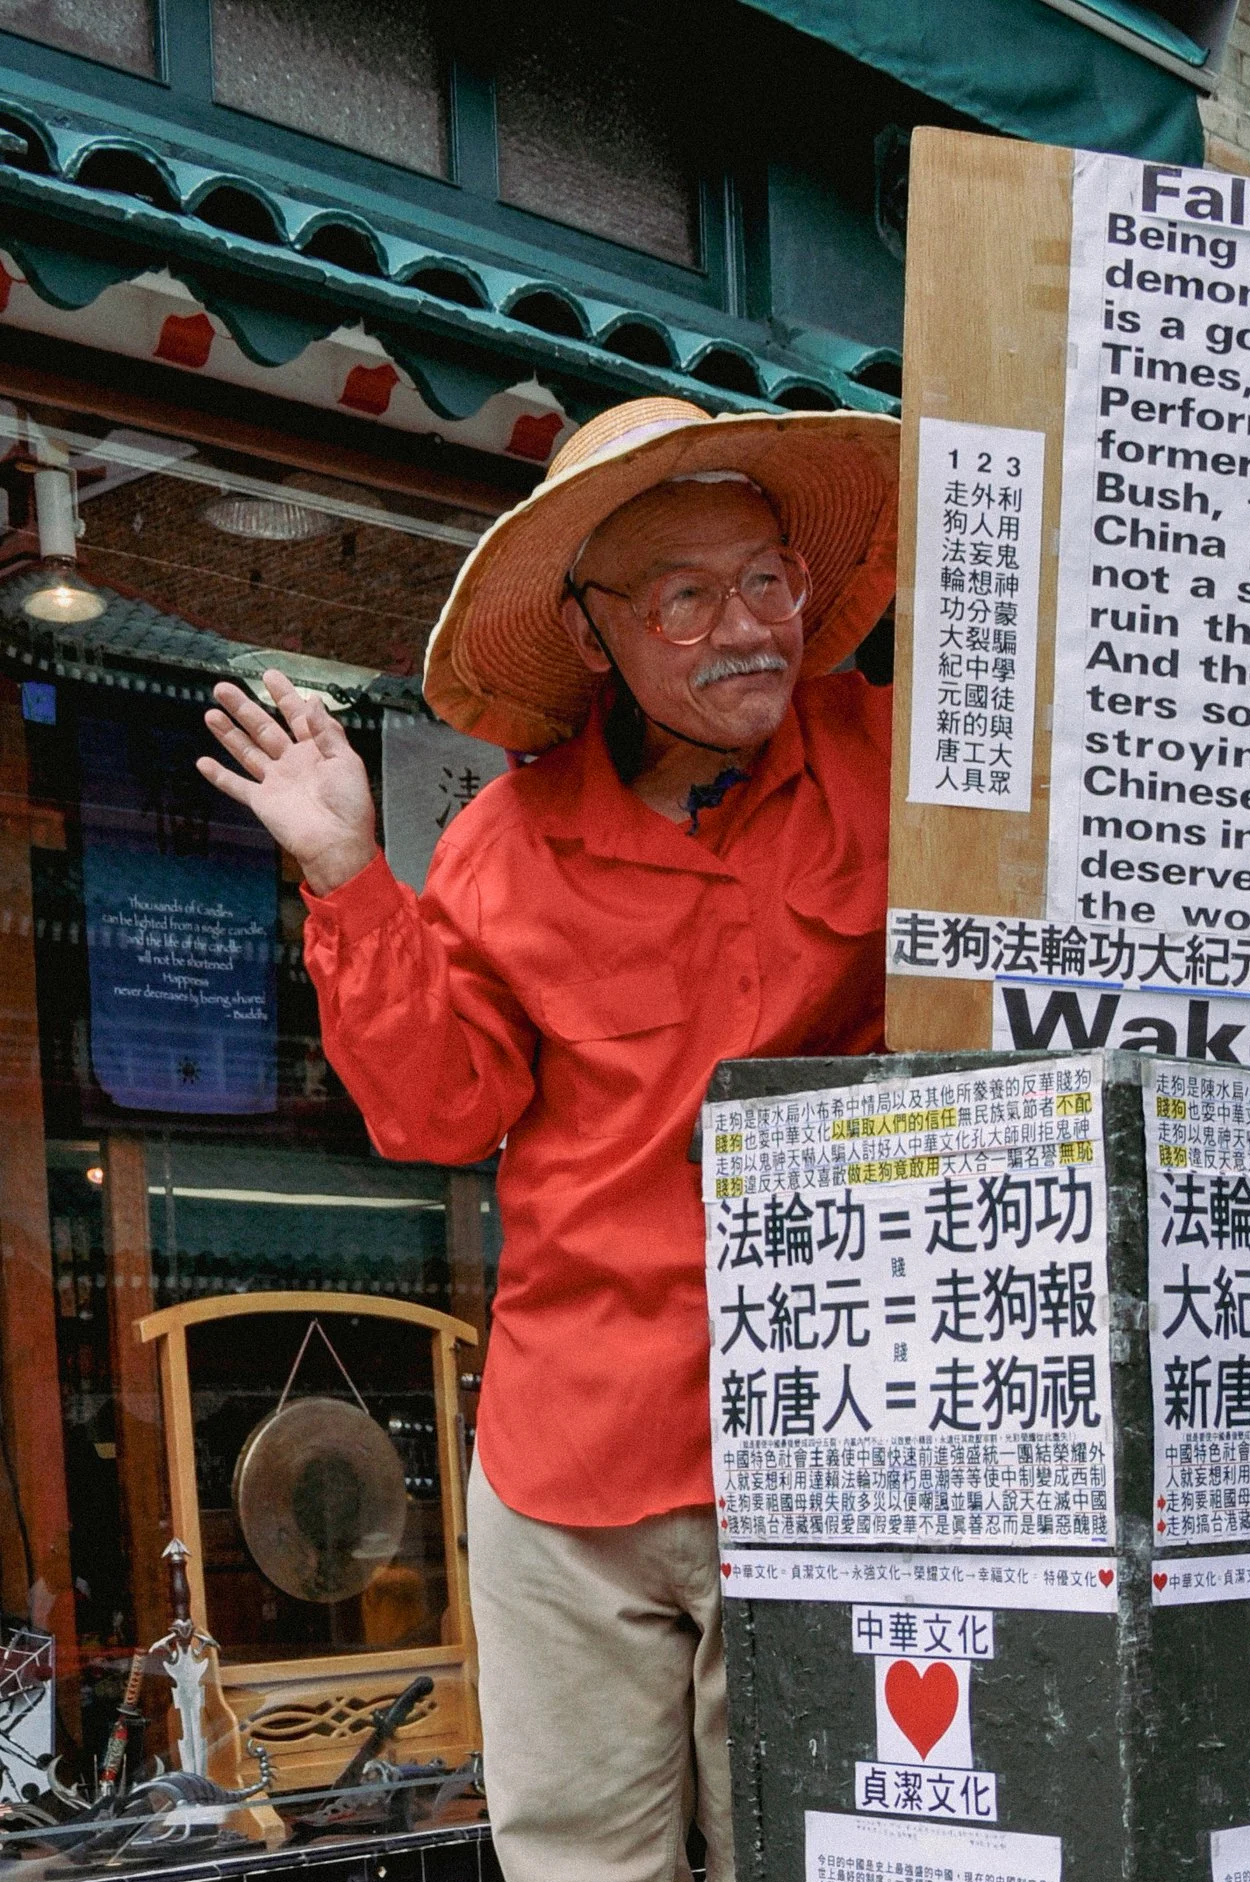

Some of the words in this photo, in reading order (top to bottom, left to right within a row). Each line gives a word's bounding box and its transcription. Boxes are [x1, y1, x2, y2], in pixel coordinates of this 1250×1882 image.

[1109, 213, 1236, 269] Being
[1105, 300, 1140, 333] is
[1160, 317, 1184, 339] a
[1097, 472, 1221, 520] Bush,
[935, 479, 969, 791] 走狗法輪功大紀元新唐人
[961, 481, 996, 794] 外人妄想分裂中國的工具
[1087, 686, 1176, 719] ters
[1083, 816, 1205, 845] mons
[1078, 891, 1154, 921] the
[717, 1188, 865, 1271] 法輪功
[880, 1211, 911, 1241] =
[925, 1166, 1093, 1254] 走狗功
[720, 1278, 870, 1355] 大紀元
[885, 1295, 916, 1324] =
[931, 1262, 1097, 1344] 走狗報
[721, 1363, 872, 1437] 新唐人
[886, 1381, 916, 1410] =
[929, 1354, 1101, 1433] 走狗視
[855, 1611, 989, 1656] 中華文化
[862, 1767, 992, 1818] 貞潔文化
